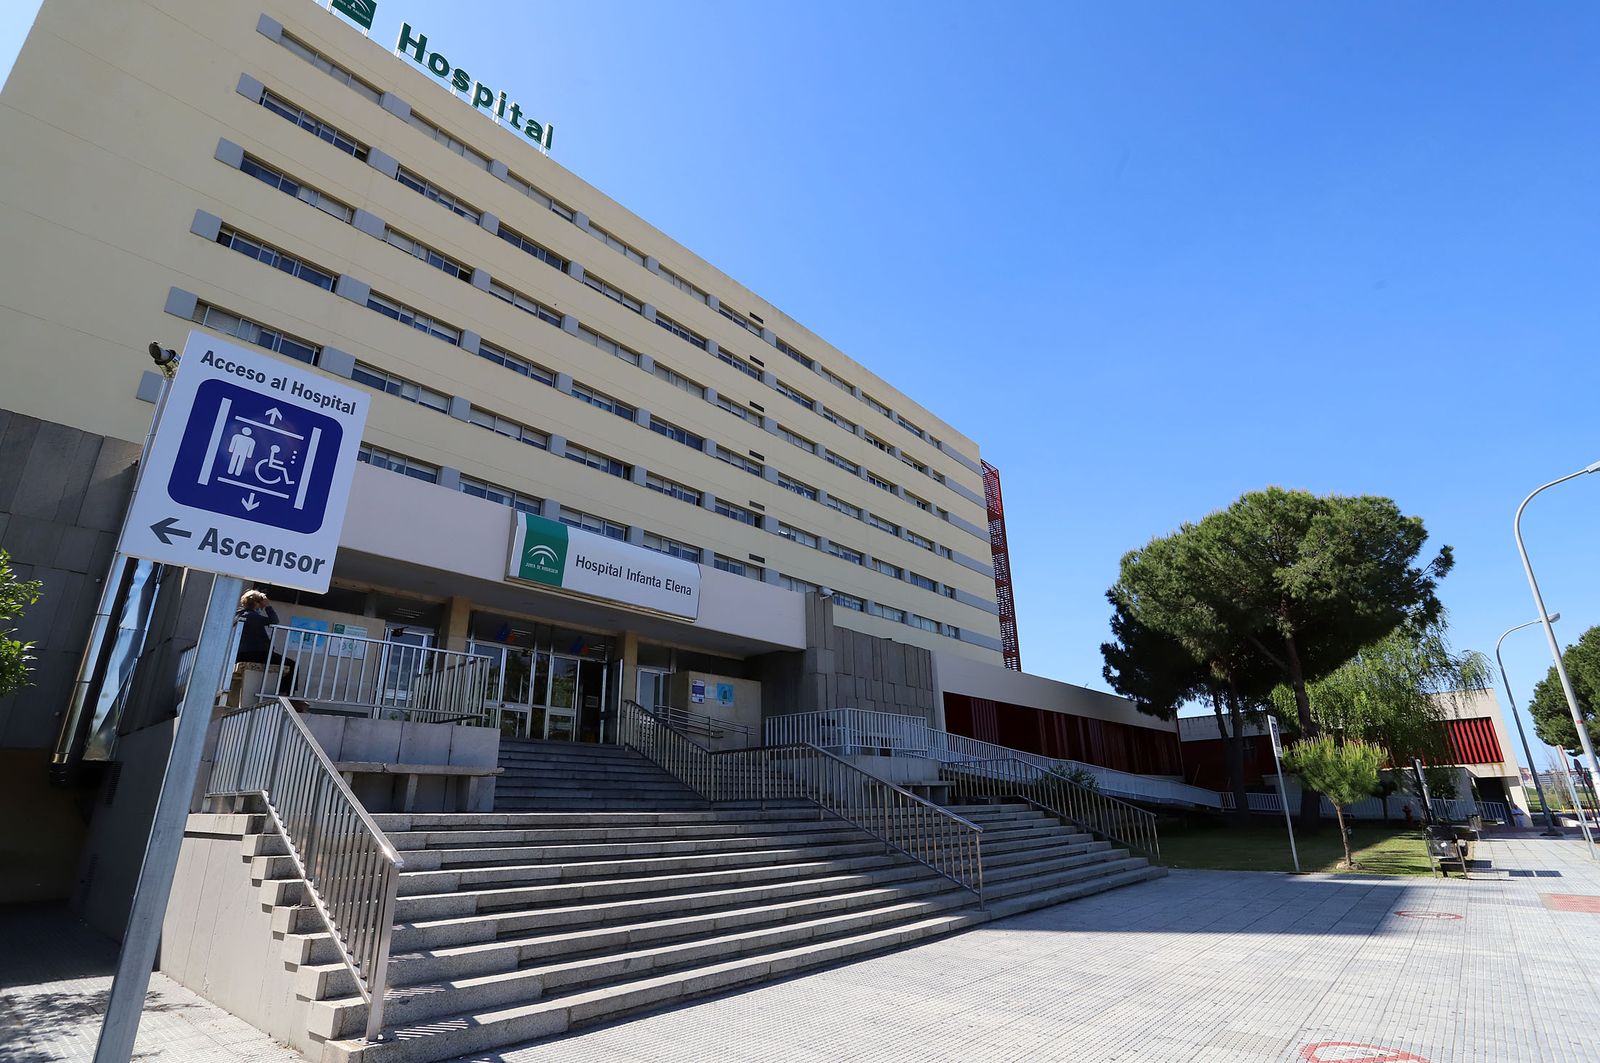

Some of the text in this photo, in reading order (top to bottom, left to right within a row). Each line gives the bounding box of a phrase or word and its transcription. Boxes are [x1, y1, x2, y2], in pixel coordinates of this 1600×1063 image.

[398, 22, 554, 150] Hospital
[201, 350, 356, 415] Acceso al Hospital
[198, 527, 326, 575] Ascensor
[575, 554, 622, 578] Hospital
[627, 568, 661, 588] Infanta
[665, 579, 692, 596] Elena
